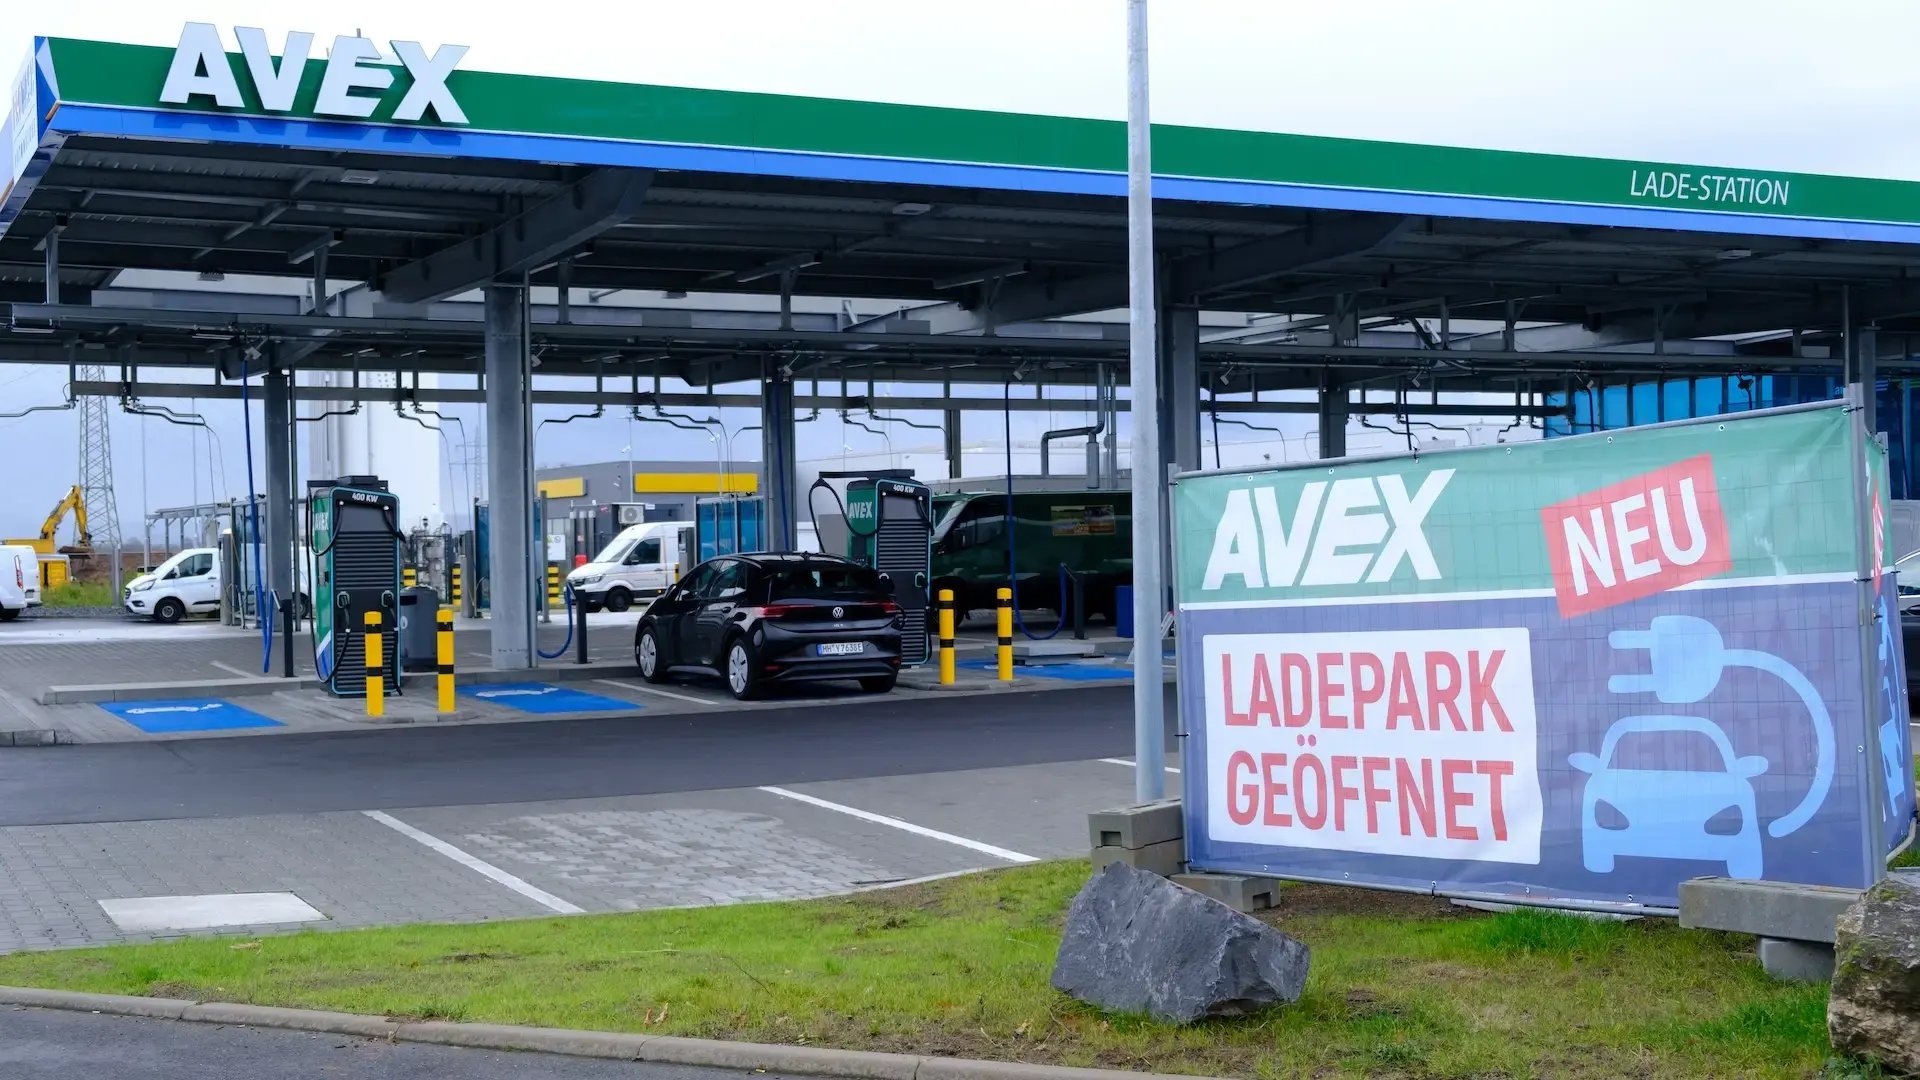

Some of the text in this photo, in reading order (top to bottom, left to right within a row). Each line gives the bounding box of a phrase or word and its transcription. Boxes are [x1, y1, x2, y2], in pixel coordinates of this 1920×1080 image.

[159, 21, 471, 124] AVEX
[1630, 169, 1790, 206] LADE-STATION
[352, 492, 379, 503] 400 KW
[849, 501, 873, 519] AVEX
[893, 484, 916, 494] 400 KW
[1201, 468, 1457, 590] AVEX
[1563, 477, 1707, 596] NEU
[1222, 649, 1514, 732] LADEPARK
[1227, 734, 1514, 841] GEÖFFNET
